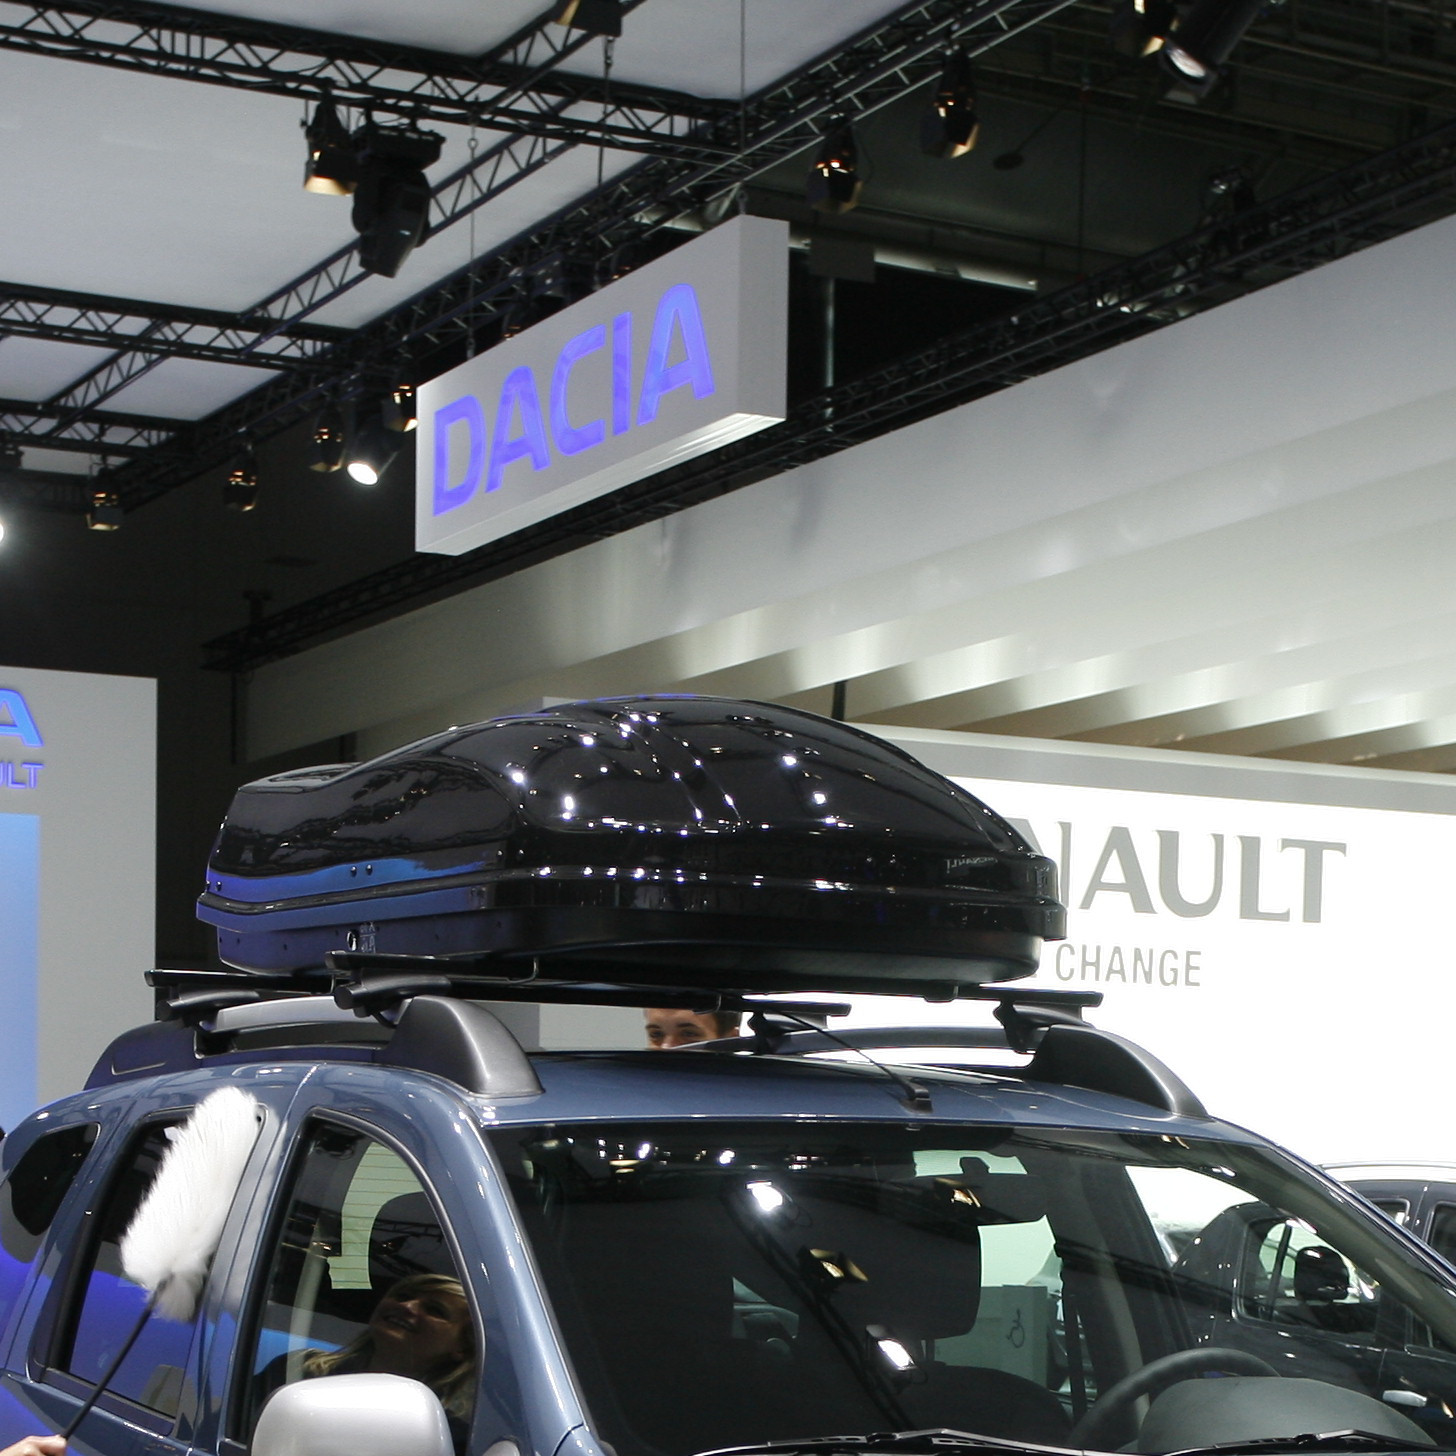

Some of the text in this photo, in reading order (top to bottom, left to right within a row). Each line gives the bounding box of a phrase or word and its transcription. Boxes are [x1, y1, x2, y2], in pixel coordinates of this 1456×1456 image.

[433, 283, 715, 516] DACIA
[1005, 817, 1348, 923] NAULT
[1055, 943, 1201, 987] CHANGE
